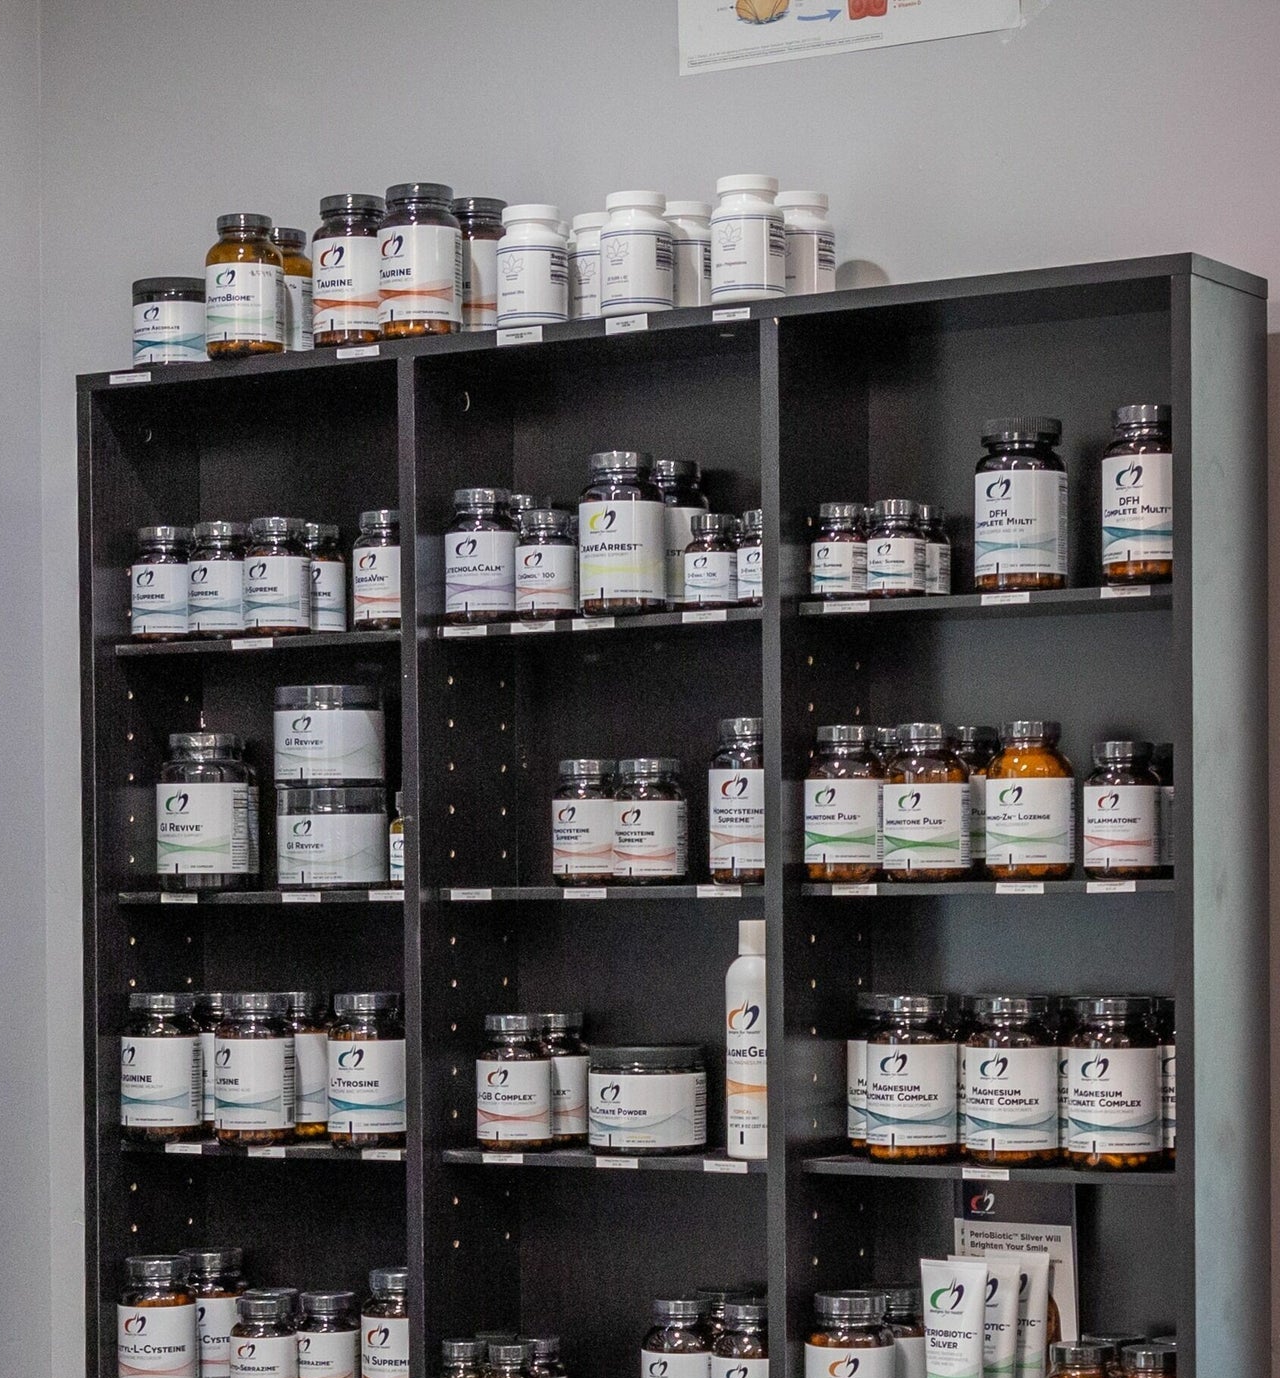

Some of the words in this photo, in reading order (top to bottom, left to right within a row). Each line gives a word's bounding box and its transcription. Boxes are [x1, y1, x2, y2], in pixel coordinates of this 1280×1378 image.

[1119, 497, 1140, 506] DFH
[989, 510, 1008, 518] DFH
[1020, 1232, 1043, 1242] Silver
[1044, 1234, 1061, 1243] Will
[970, 1241, 1002, 1252] Brighten
[1004, 1241, 1025, 1251] Your
[1027, 1243, 1049, 1253] Smile
